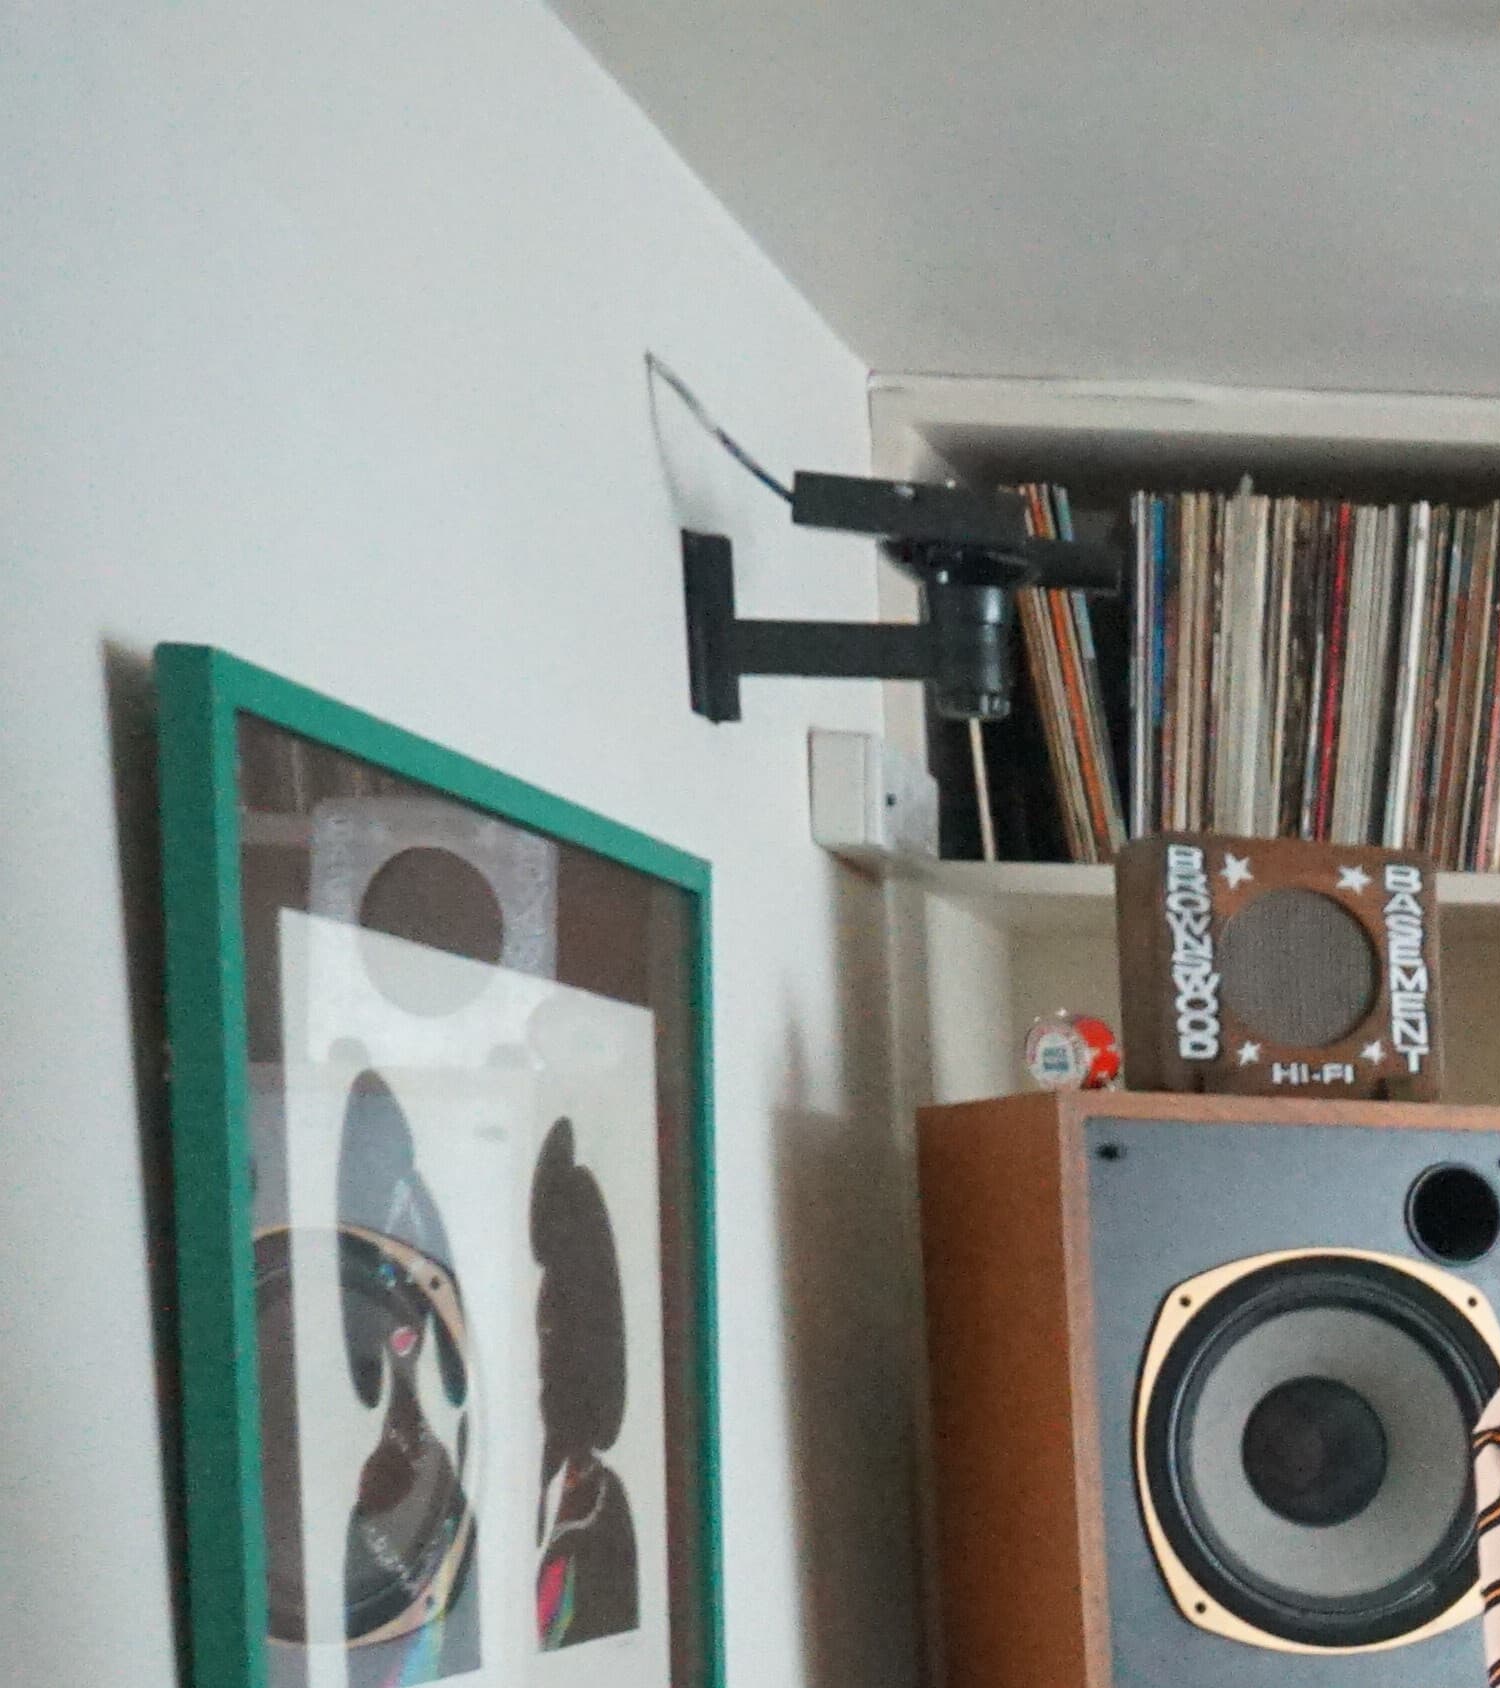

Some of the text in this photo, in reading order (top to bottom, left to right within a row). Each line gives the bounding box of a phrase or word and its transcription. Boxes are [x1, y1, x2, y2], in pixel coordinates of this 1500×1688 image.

[1166, 844, 1221, 1060] BROWNSWOOD
[1383, 864, 1429, 1073] BASEMENT
[1272, 1062, 1355, 1086] HI-FI
